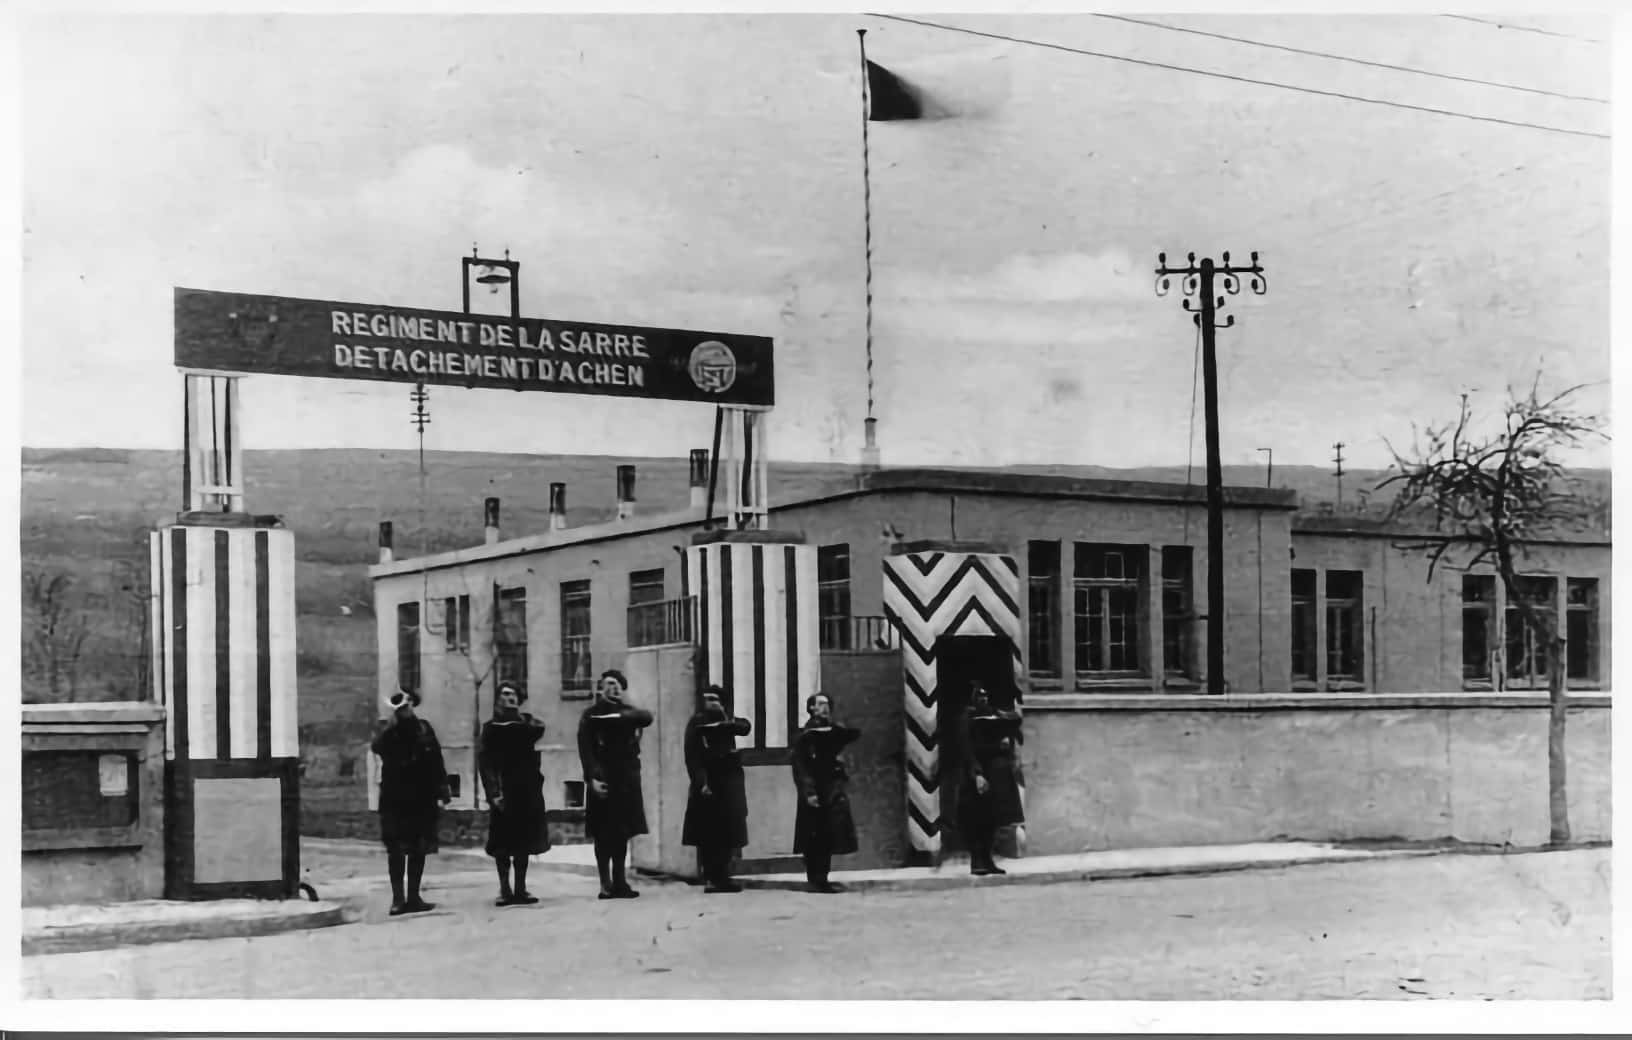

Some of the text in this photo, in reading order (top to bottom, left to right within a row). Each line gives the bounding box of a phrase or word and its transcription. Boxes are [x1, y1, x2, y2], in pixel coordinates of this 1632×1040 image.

[331, 311, 650, 358] REGIMENT DE LA SARRE
[335, 344, 645, 387] DETACHEMENT D'ACHEN
